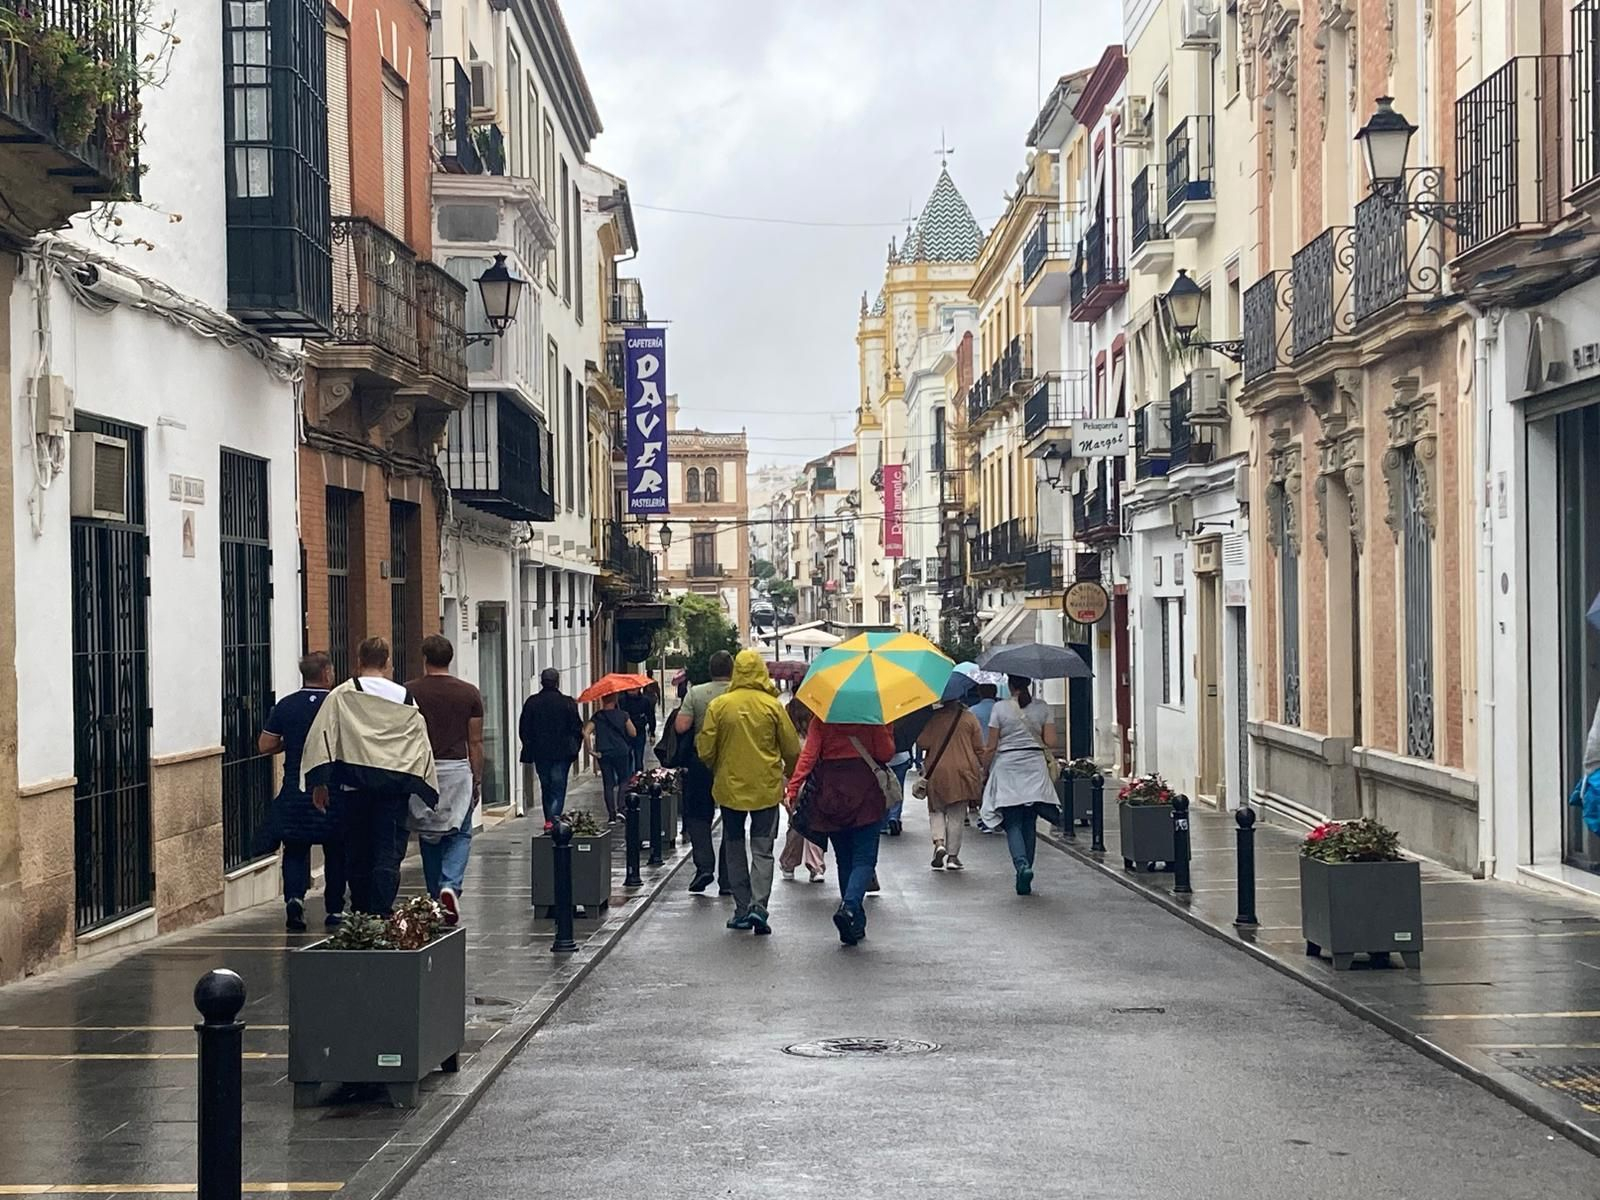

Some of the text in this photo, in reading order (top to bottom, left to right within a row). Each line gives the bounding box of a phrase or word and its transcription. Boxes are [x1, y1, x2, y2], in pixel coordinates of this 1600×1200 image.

[628, 337, 662, 348] CAFETERÍA
[632, 353, 662, 494] DAVER
[1078, 433, 1124, 452] Margot
[631, 498, 665, 508] PASTELERÍA
